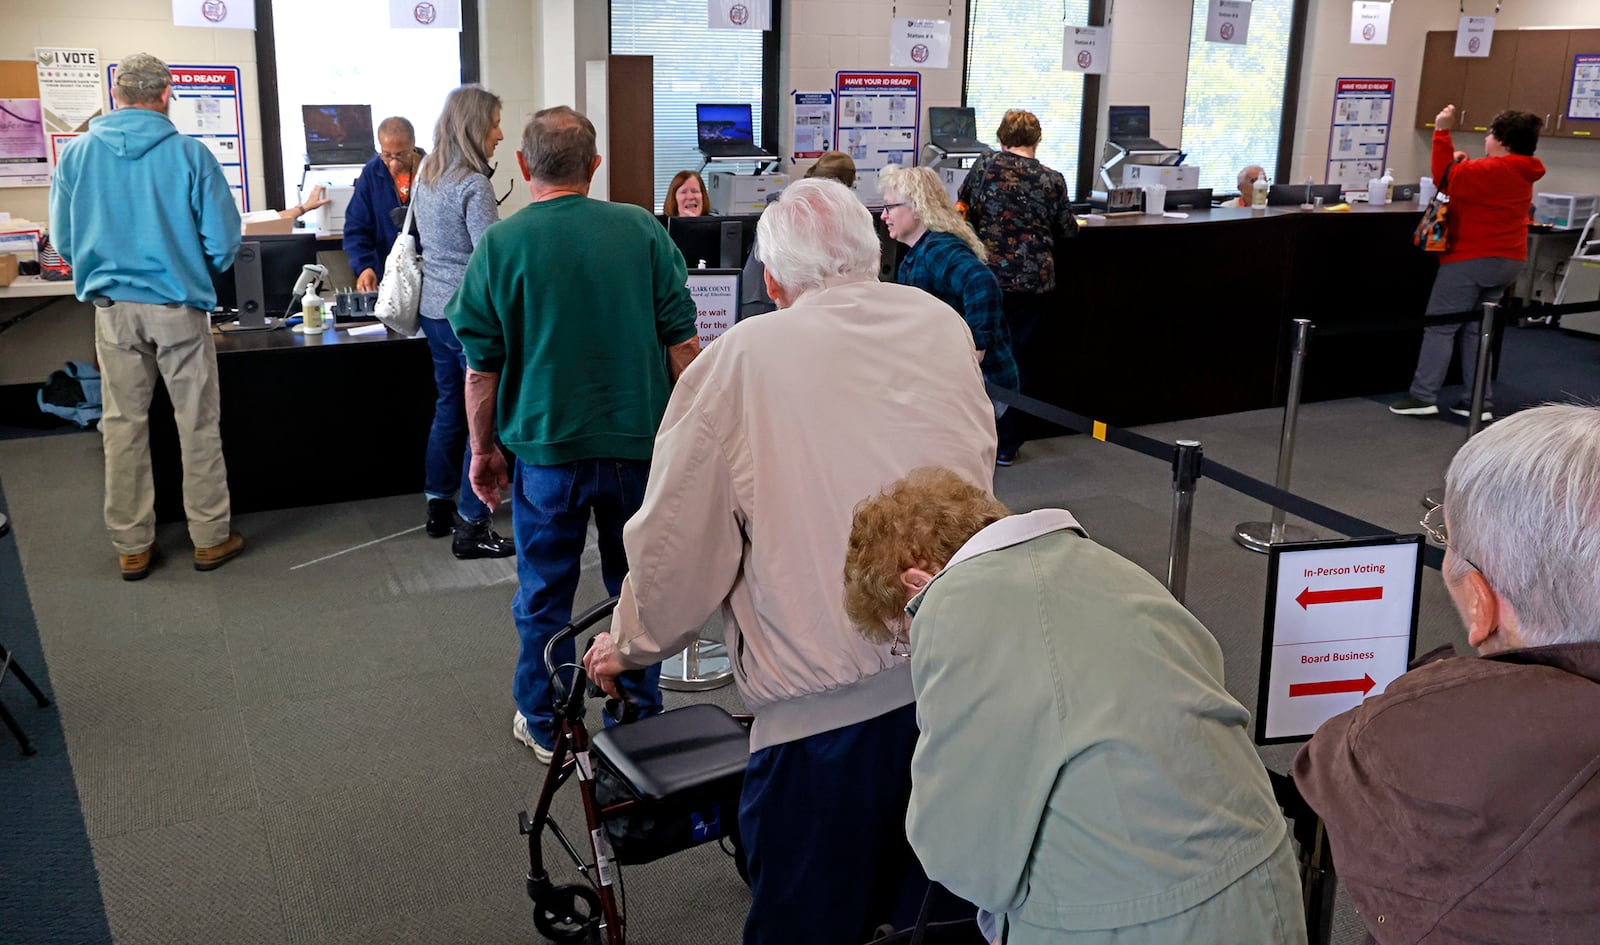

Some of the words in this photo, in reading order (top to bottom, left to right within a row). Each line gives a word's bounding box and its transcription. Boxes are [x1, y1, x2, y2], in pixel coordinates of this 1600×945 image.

[54, 52, 58, 63] I
[62, 52, 96, 64] VOTE
[1304, 567, 1350, 578] In-Person
[1353, 564, 1386, 574] Voting
[1301, 654, 1330, 664] Board
[1333, 652, 1374, 661] Business
